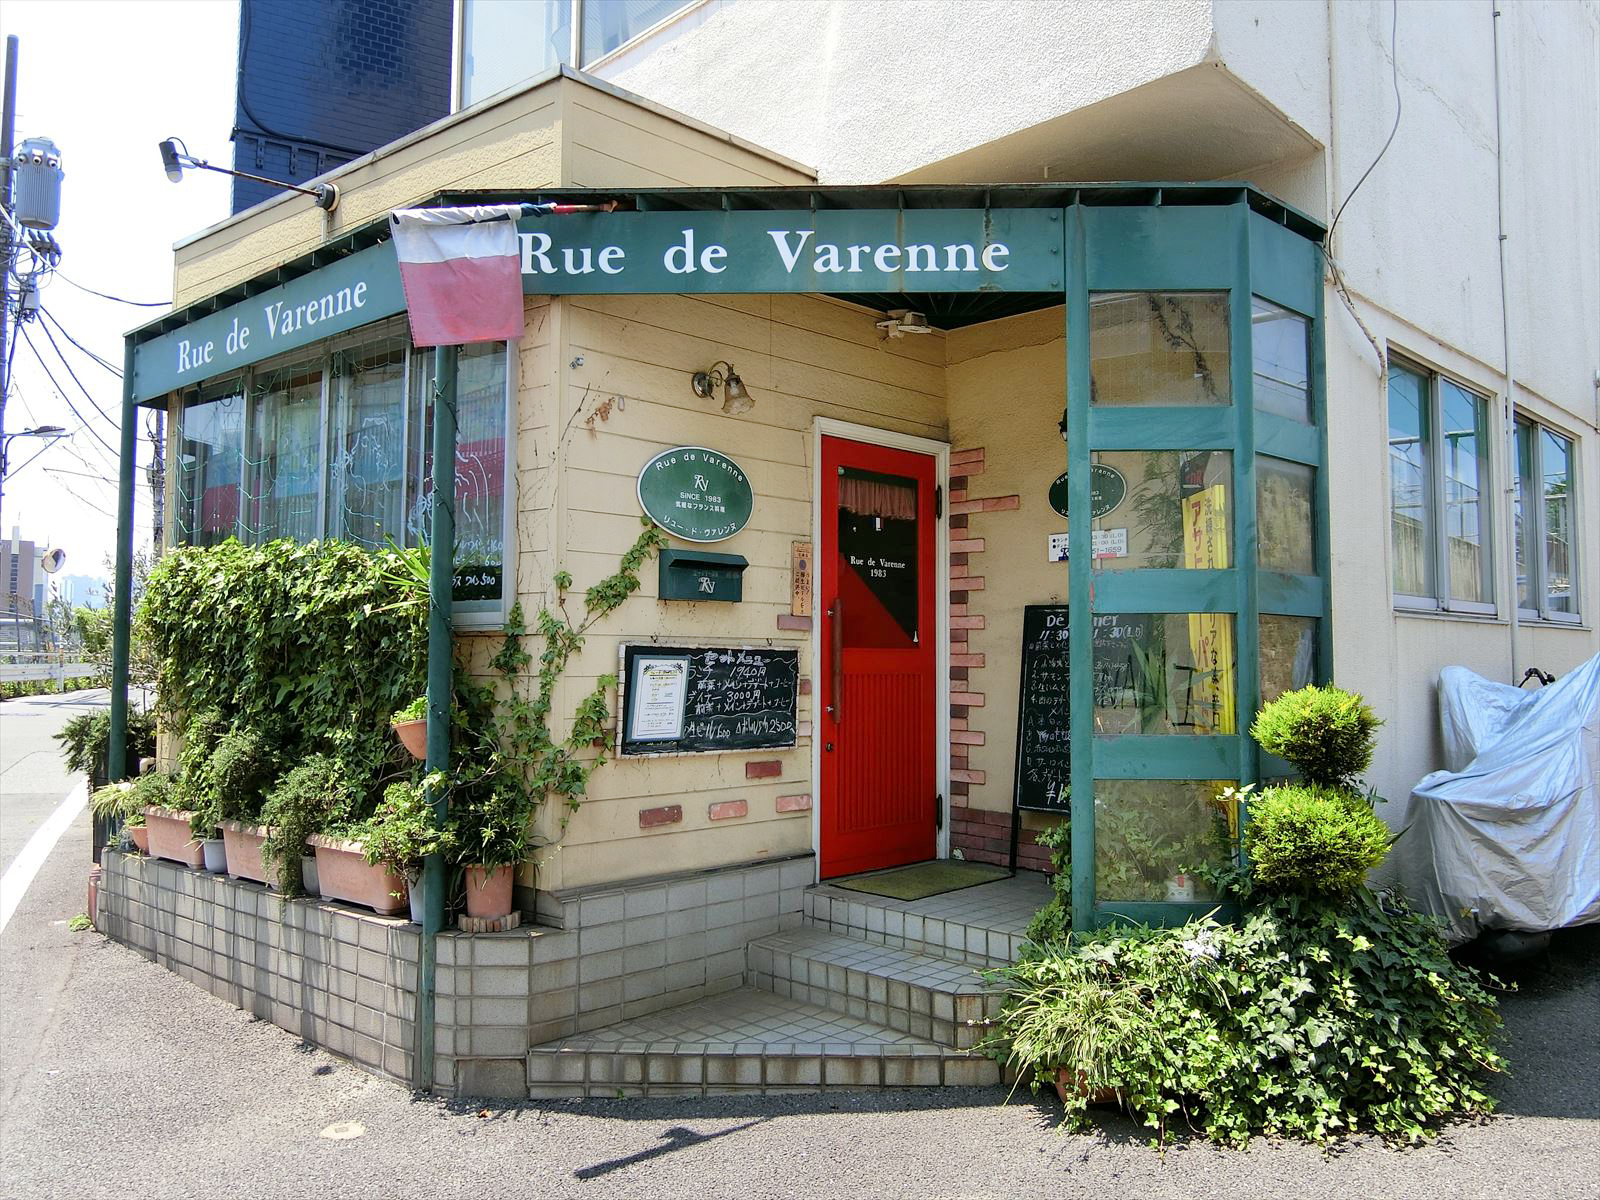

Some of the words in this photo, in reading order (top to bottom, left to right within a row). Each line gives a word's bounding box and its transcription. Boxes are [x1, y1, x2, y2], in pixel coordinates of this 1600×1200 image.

[518, 231, 626, 275] Rue
[663, 228, 728, 274] de
[767, 229, 1010, 273] Varenne
[177, 339, 214, 374] Rue
[225, 316, 250, 355] de
[264, 281, 367, 340] Varenne
[656, 457, 677, 471] Rue
[683, 453, 695, 461] de
[702, 453, 743, 482] Varenne
[704, 495, 722, 503] 1983
[850, 555, 864, 566] Rue
[867, 556, 876, 566] de
[879, 558, 906, 569] Varenne
[870, 568, 887, 578] 1983
[727, 690, 761, 702] 3000円
